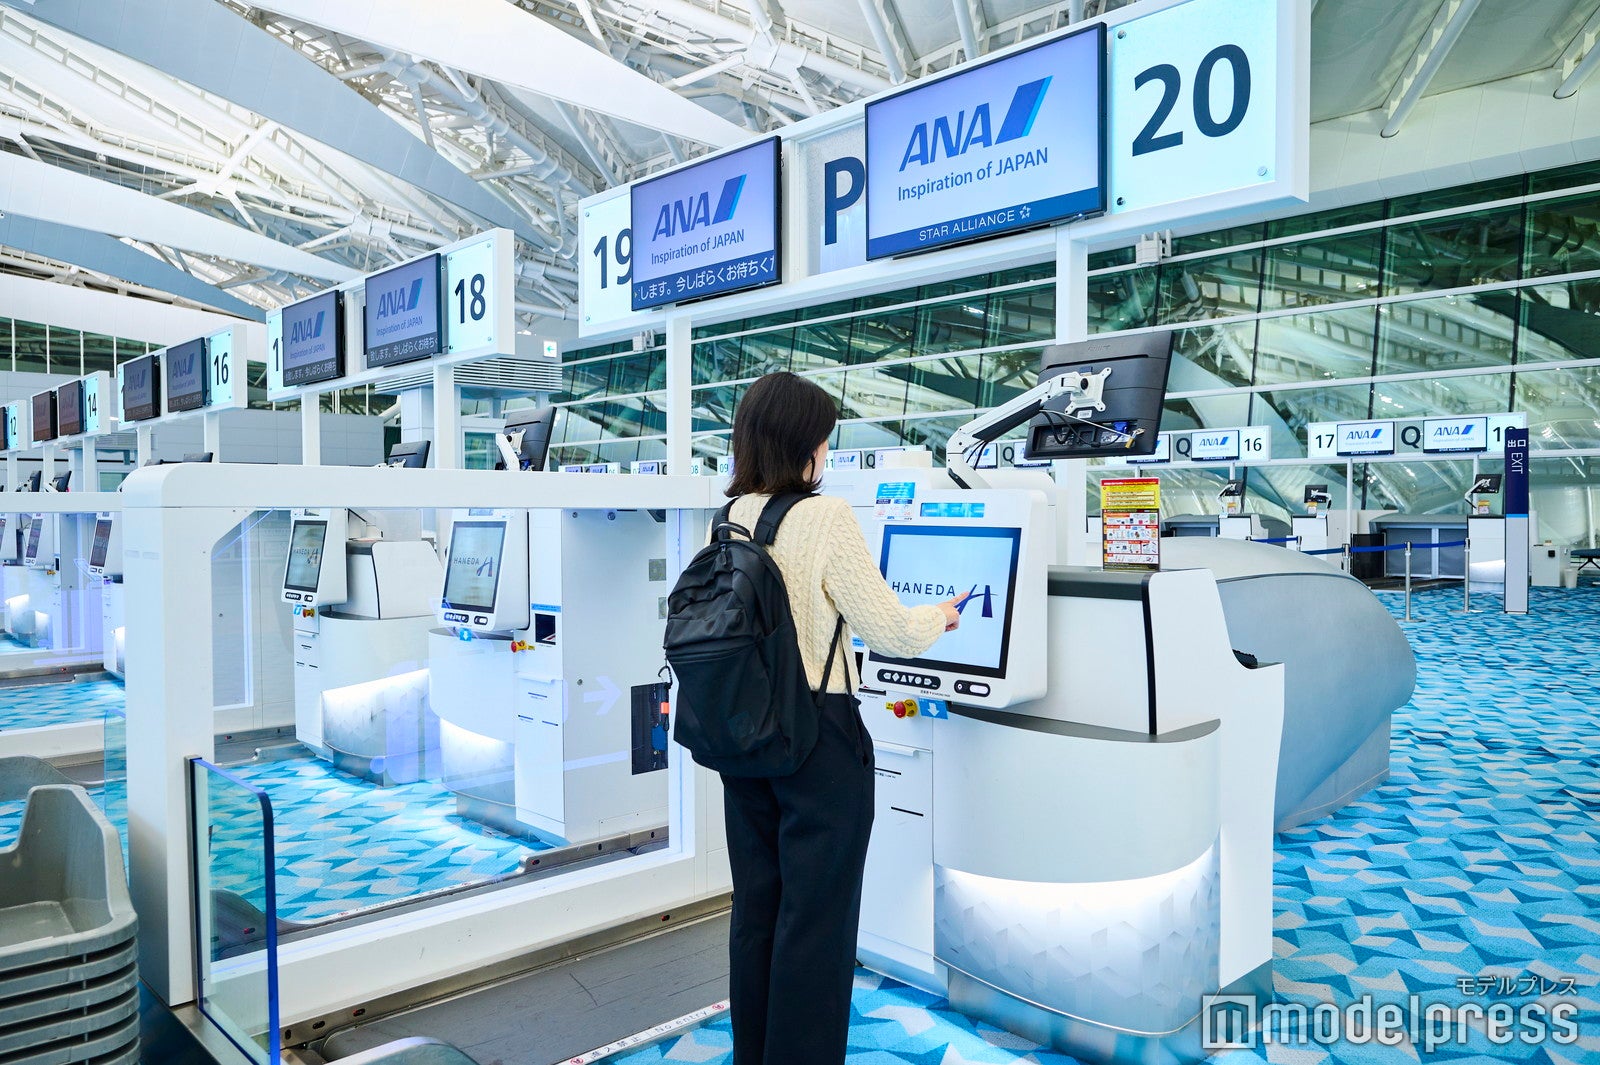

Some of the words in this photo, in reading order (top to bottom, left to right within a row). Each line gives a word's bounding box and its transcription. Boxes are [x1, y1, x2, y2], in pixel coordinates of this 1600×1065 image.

[1132, 44, 1251, 157] 20
[899, 102, 992, 172] ANA
[898, 171, 973, 202] Inspiration
[976, 161, 992, 181] of
[995, 147, 1048, 177] JAPAN
[824, 156, 866, 246] P
[652, 191, 711, 242] ANA
[919, 224, 949, 242] STAR
[952, 210, 1016, 235] ALLIANCE
[651, 243, 699, 265] Inspiration
[700, 237, 711, 252] of
[712, 229, 745, 250] JAPAN
[593, 228, 631, 290] 19
[376, 287, 406, 320] ANA
[454, 273, 486, 324] 18
[290, 318, 313, 345] ANA
[375, 322, 401, 338] Inspiration
[406, 316, 423, 329] JAPAN
[213, 352, 229, 386] 16
[87, 392, 97, 418] 14
[10, 416, 17, 436] 12
[1346, 430, 1370, 440] ANA
[1401, 425, 1421, 449] Q
[1434, 426, 1460, 437] ANA
[1175, 437, 1191, 458] Q
[1199, 438, 1220, 447] ANA
[1244, 437, 1262, 452] 16
[1315, 434, 1335, 449] 17
[1507, 439, 1526, 448] 出口
[866, 453, 876, 469] Q
[1002, 446, 1014, 465] Q
[1511, 452, 1523, 475] EXIT
[719, 463, 729, 473] 09
[453, 557, 480, 565] HANEDA
[891, 581, 956, 597] HANEDA
